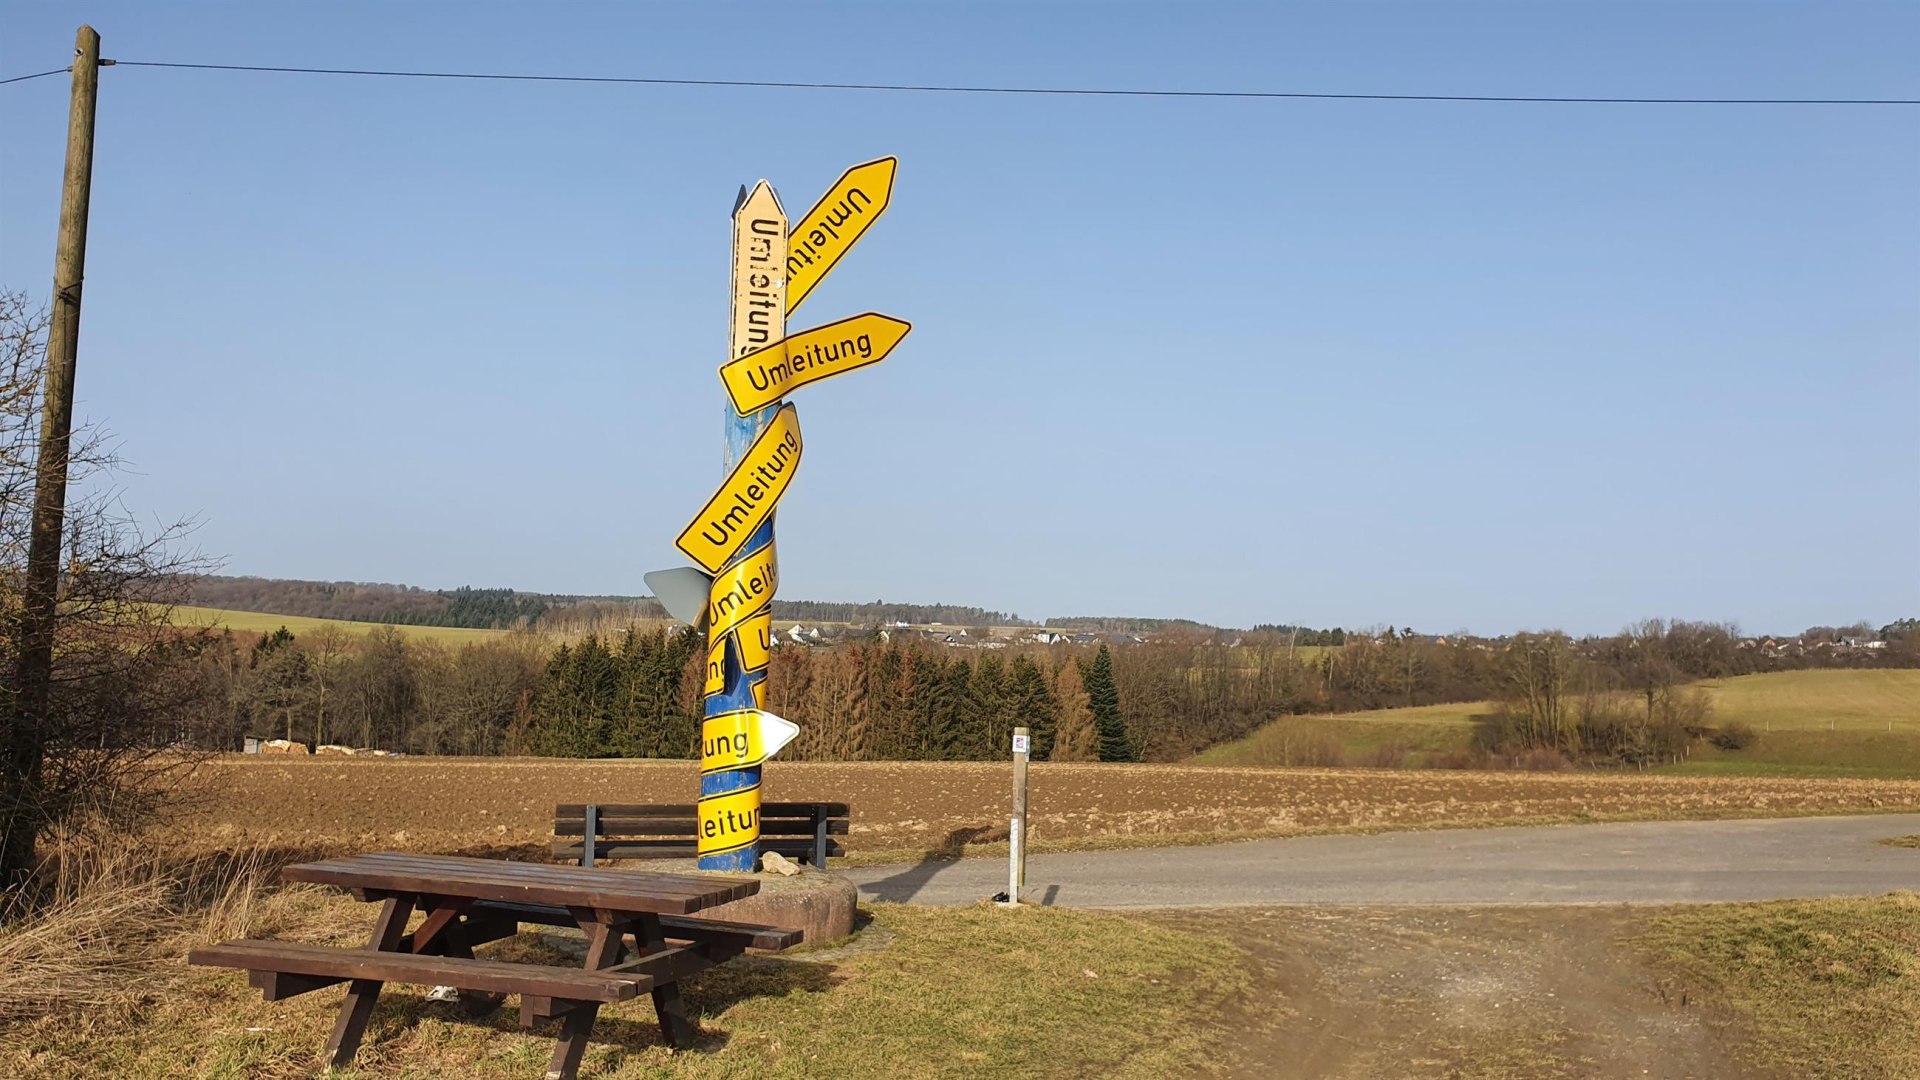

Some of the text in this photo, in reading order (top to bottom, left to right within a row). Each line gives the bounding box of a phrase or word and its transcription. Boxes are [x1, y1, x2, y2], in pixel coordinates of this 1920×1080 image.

[786, 188, 872, 286] Umleitu
[747, 333, 872, 391] Umleitung
[702, 429, 798, 546] Umleitung
